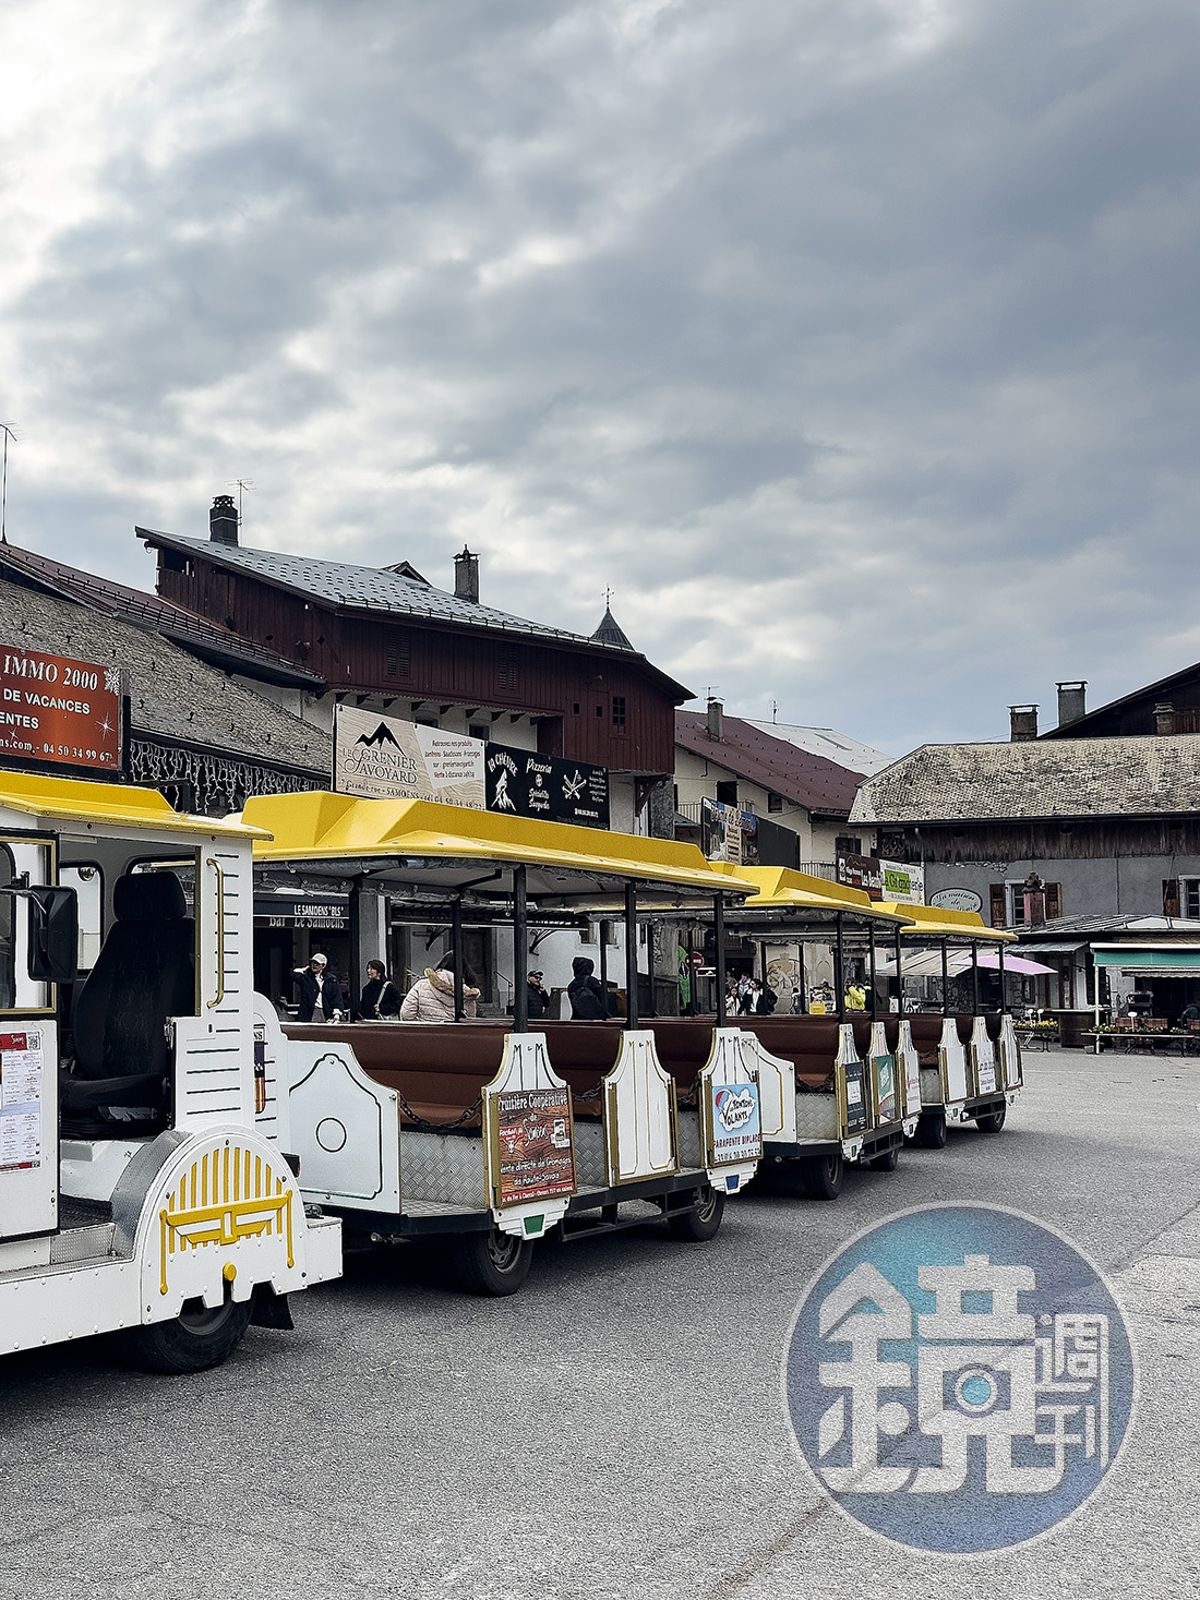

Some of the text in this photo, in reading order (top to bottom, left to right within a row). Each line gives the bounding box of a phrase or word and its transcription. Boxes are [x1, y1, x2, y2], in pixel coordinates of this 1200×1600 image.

[3, 654, 58, 683] IMMO
[63, 667, 98, 691] 2000
[3, 688, 21, 702] DE
[25, 692, 90, 714] VACANCES
[43, 743, 55, 754] 04
[58, 745, 69, 756] 50
[72, 747, 83, 758] 34
[85, 749, 97, 760] 99
[352, 748, 417, 770] GRENIER
[344, 757, 417, 784] SAVOYARD
[294, 904, 301, 915] LE
